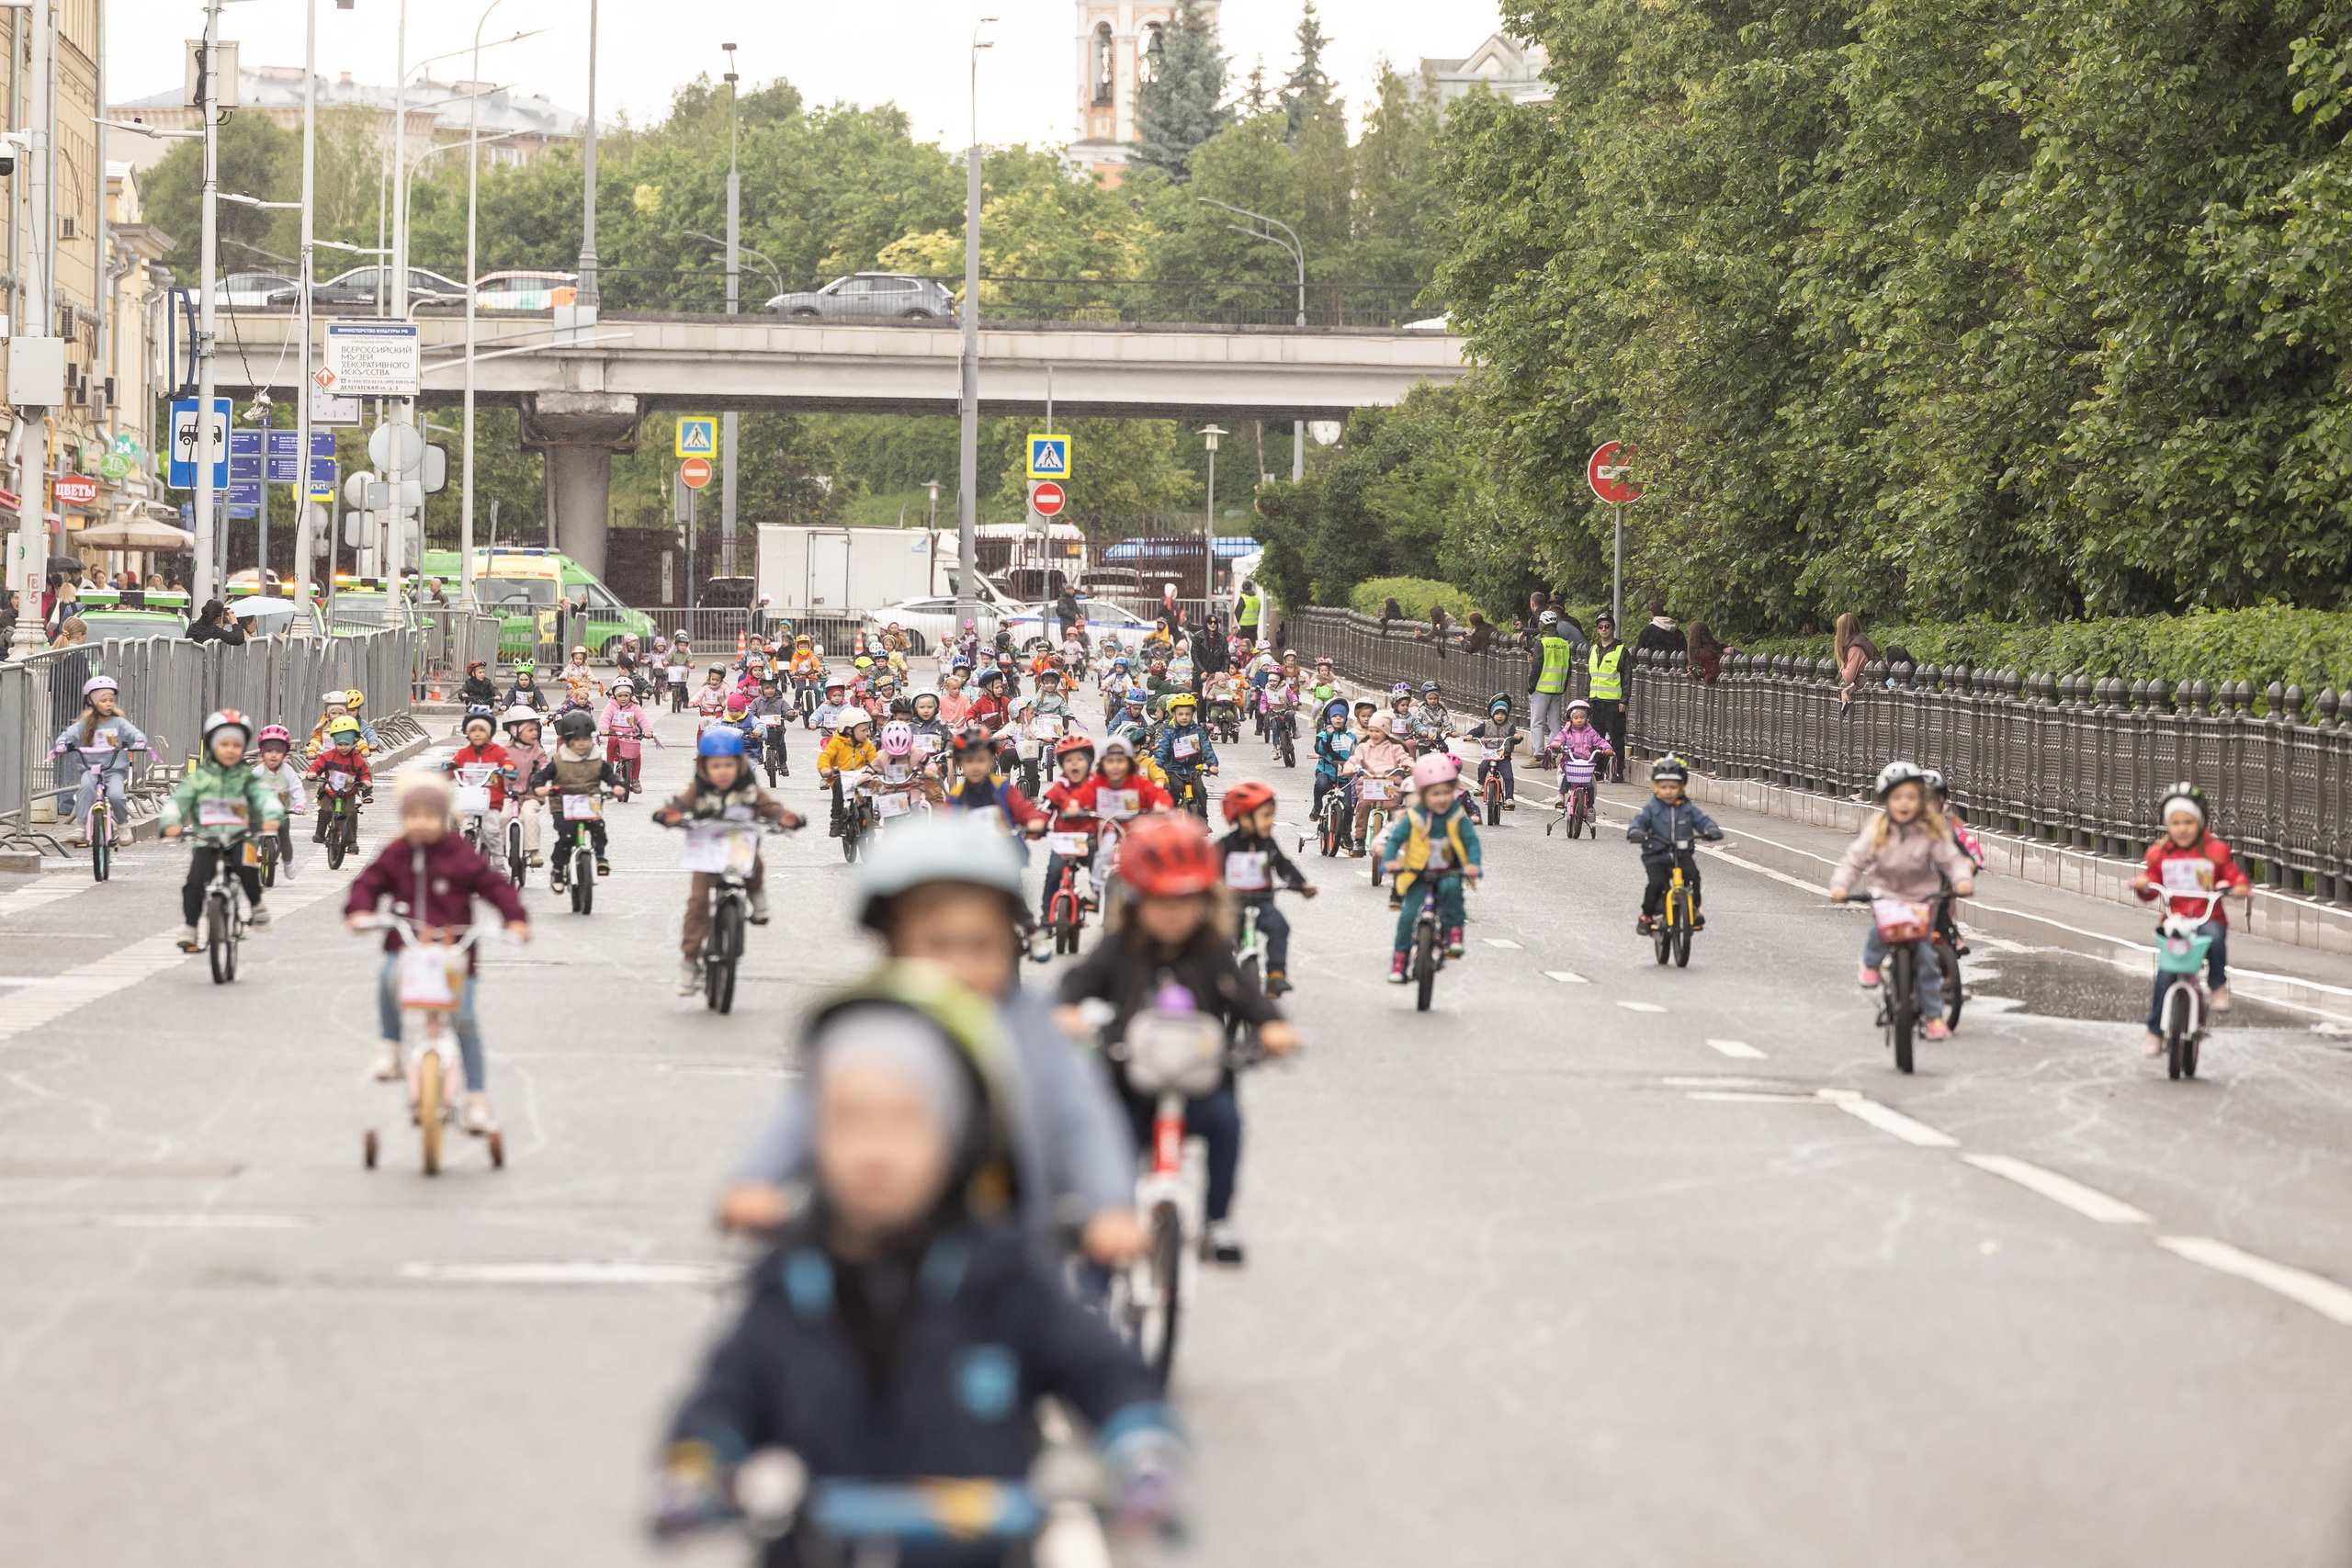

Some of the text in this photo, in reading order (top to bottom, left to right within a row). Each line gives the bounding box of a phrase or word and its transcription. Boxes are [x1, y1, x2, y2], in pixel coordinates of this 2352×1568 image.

[116, 441, 131, 454] 24
[55, 483, 96, 497] ЦВЕТЫ
[29, 591, 39, 605] 5
